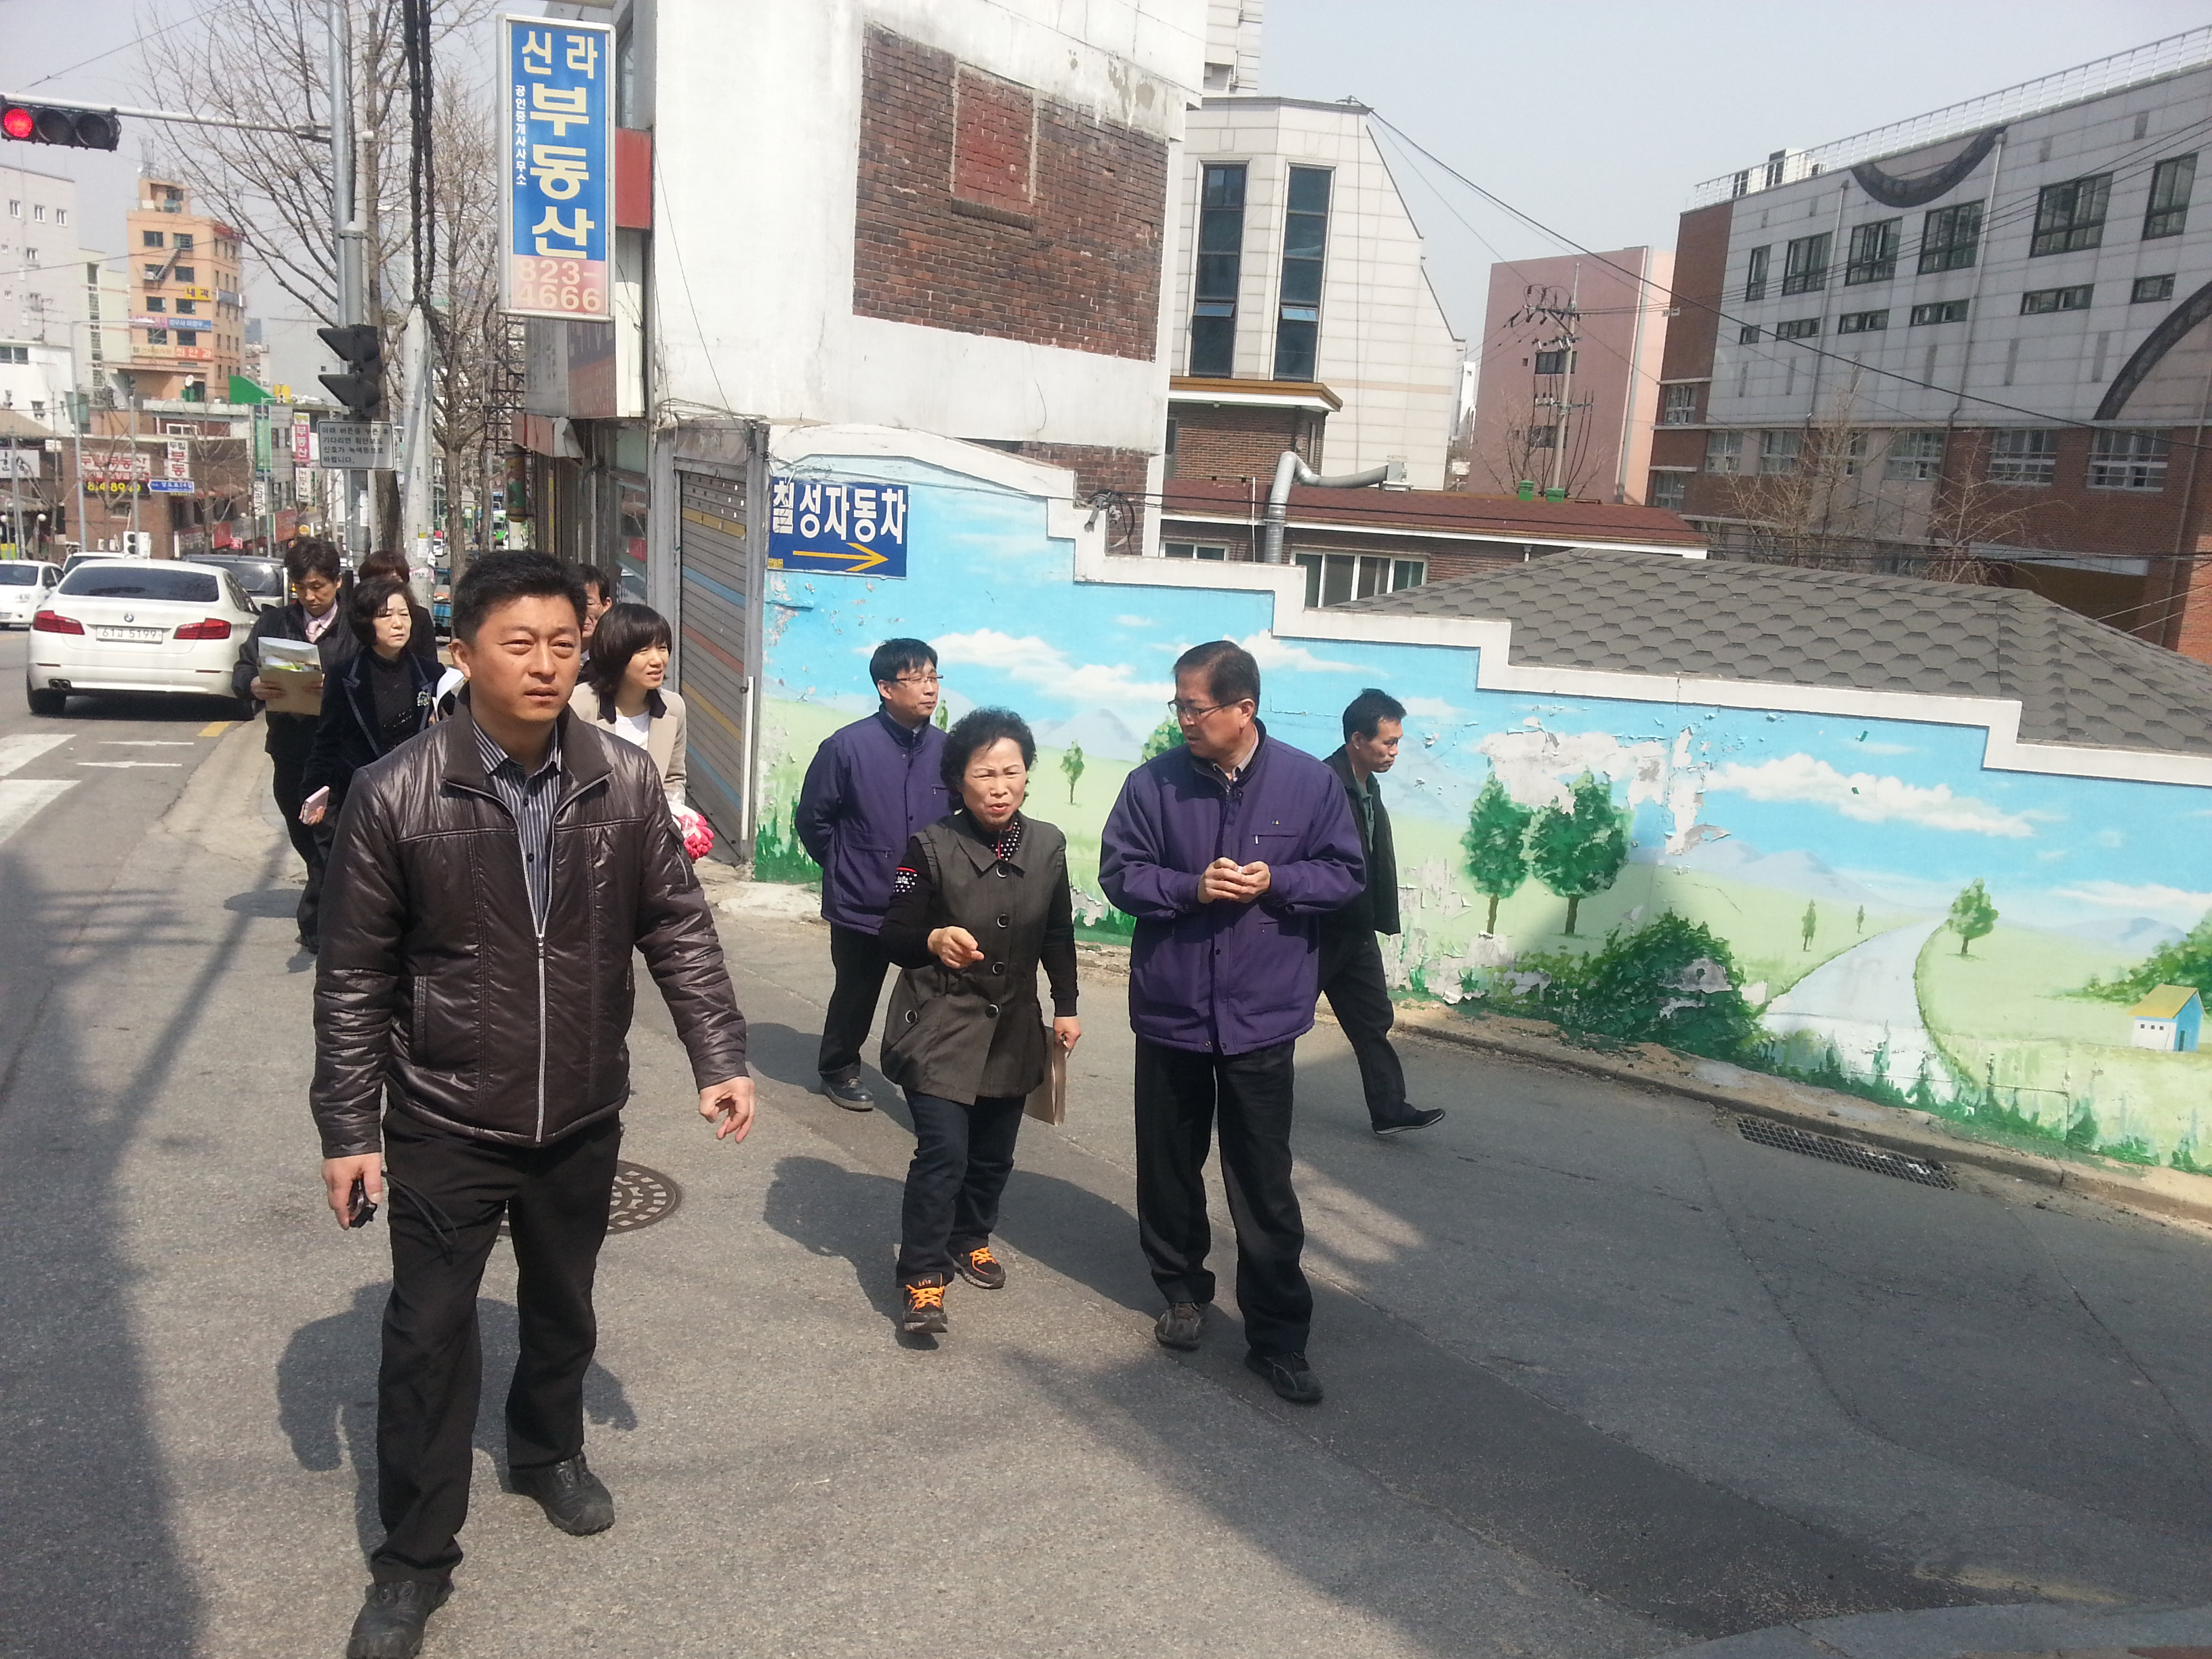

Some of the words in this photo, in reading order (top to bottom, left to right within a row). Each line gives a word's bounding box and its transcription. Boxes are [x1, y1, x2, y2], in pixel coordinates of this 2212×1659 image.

[522, 30, 598, 79] 신라
[515, 85, 527, 185] 공인중개사사무소
[530, 83, 594, 259] 부동산
[518, 259, 600, 285] 823-
[516, 284, 600, 311] 4666
[298, 426, 308, 457] 부동산
[773, 480, 907, 544] 철성자동차
[129, 629, 157, 639] 5199
